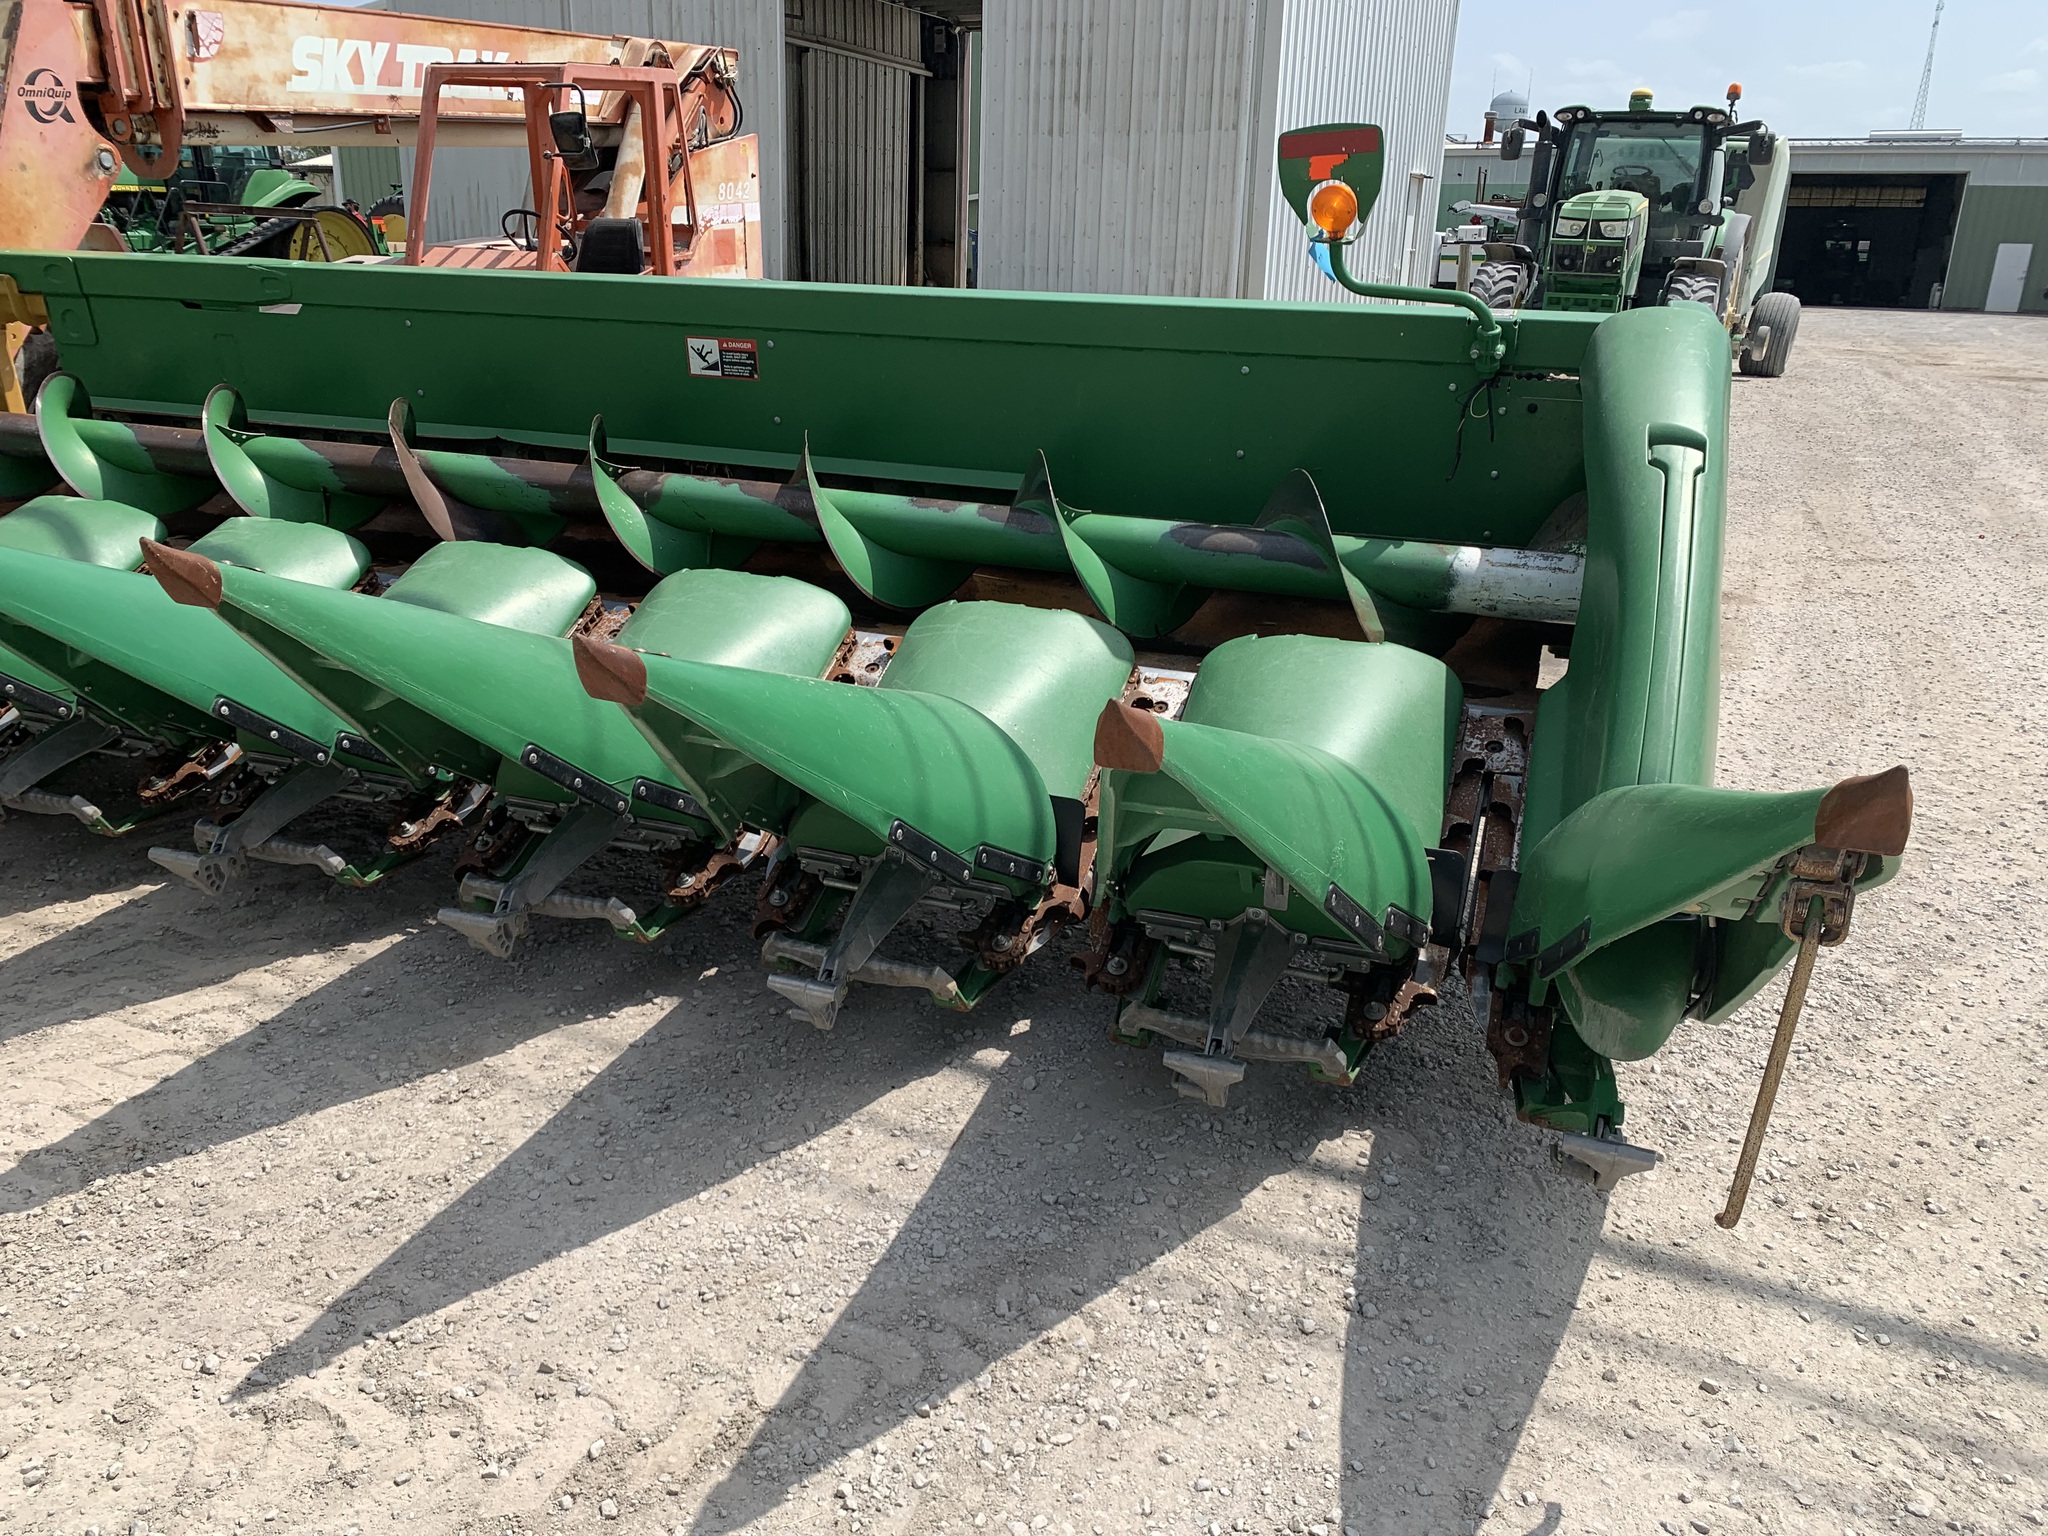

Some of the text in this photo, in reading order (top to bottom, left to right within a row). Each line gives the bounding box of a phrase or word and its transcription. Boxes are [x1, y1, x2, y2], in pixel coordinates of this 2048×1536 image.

[289, 36, 390, 93] SKY
[17, 86, 72, 100] OmniQuip
[718, 181, 750, 201] 8042
[728, 341, 752, 349] DANGER
